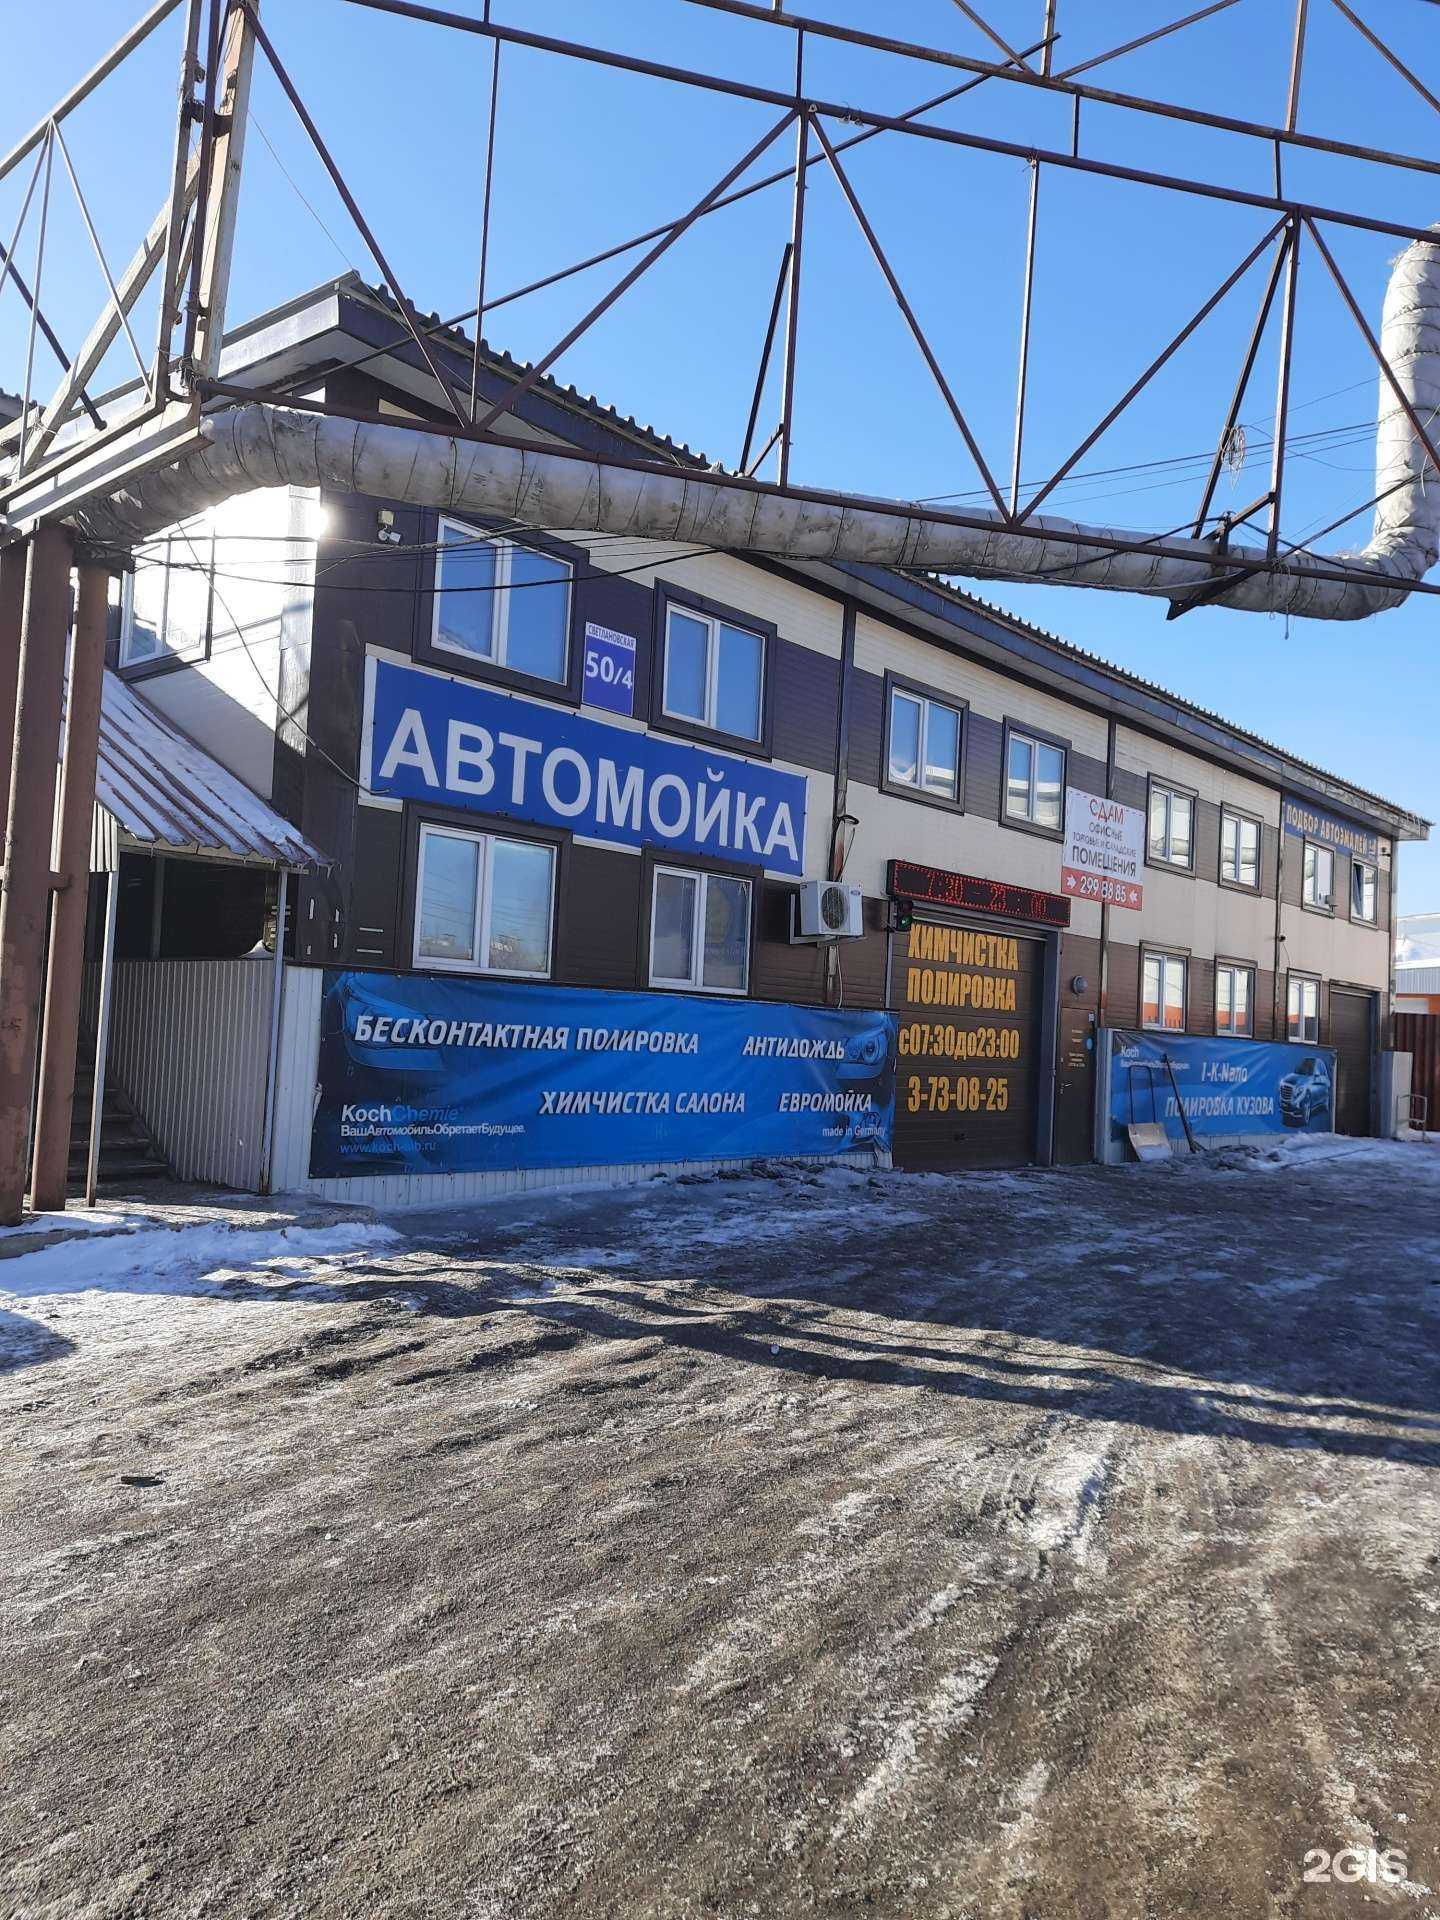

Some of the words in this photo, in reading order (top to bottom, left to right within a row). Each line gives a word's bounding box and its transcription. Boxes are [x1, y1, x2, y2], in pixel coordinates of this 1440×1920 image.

[588, 624, 634, 648] СВЕТЛАНОВСКАЯ
[585, 650, 633, 690] 50/4
[378, 707, 799, 862] АВТОМОЙКА
[1089, 798, 1124, 825] СДАМ
[1286, 804, 1319, 835] ПОДБОР
[1072, 845, 1137, 877] ПОМЕЩЕНИЯ
[1080, 875, 1099, 897] 299
[908, 923, 1019, 971] ХИМЧИСТКА
[907, 967, 1016, 1011] ПОЛИРОВКА
[354, 1015, 569, 1050] БЕСКОНТАКТНАЯ
[576, 1028, 700, 1054] ПОЛИРОВКА
[742, 1036, 845, 1060] АНТИДОЖДЬ
[1120, 1046, 1139, 1057] Koch
[539, 1091, 669, 1114] ХИМЧИСТКА
[675, 1092, 745, 1113] САЛОНА
[779, 1090, 872, 1113] ЕВРОМОЙКА
[908, 1076, 1008, 1112] 3-73-08-25
[1165, 1096, 1233, 1117] ПОЛИРОВКА
[1236, 1097, 1274, 1115] КУЗОВА
[822, 1124, 844, 1137] made
